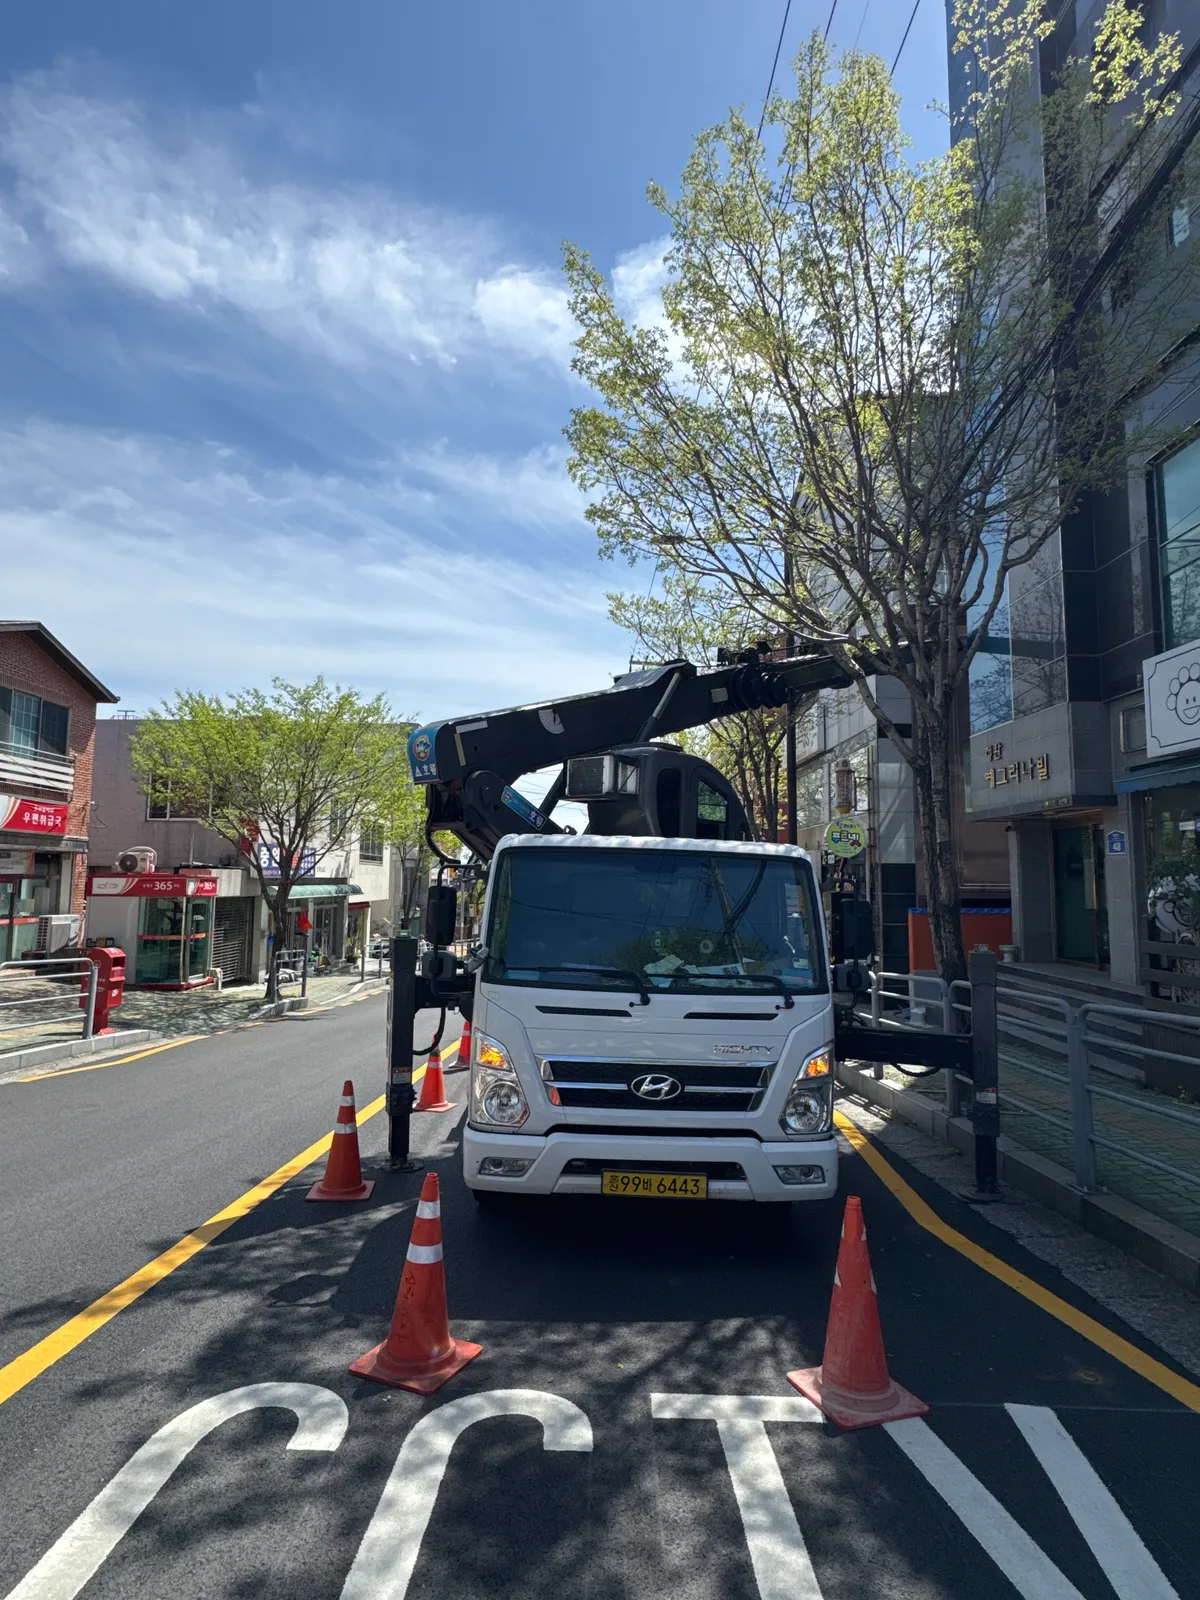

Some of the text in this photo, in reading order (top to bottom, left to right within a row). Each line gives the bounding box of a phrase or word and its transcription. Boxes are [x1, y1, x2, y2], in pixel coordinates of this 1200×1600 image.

[23, 812, 62, 828] 우편취급국
[832, 830, 862, 847] 푸르넷
[153, 881, 173, 891] 365
[713, 1044, 775, 1055] MIGHTY
[656, 1177, 700, 1195] 6443
